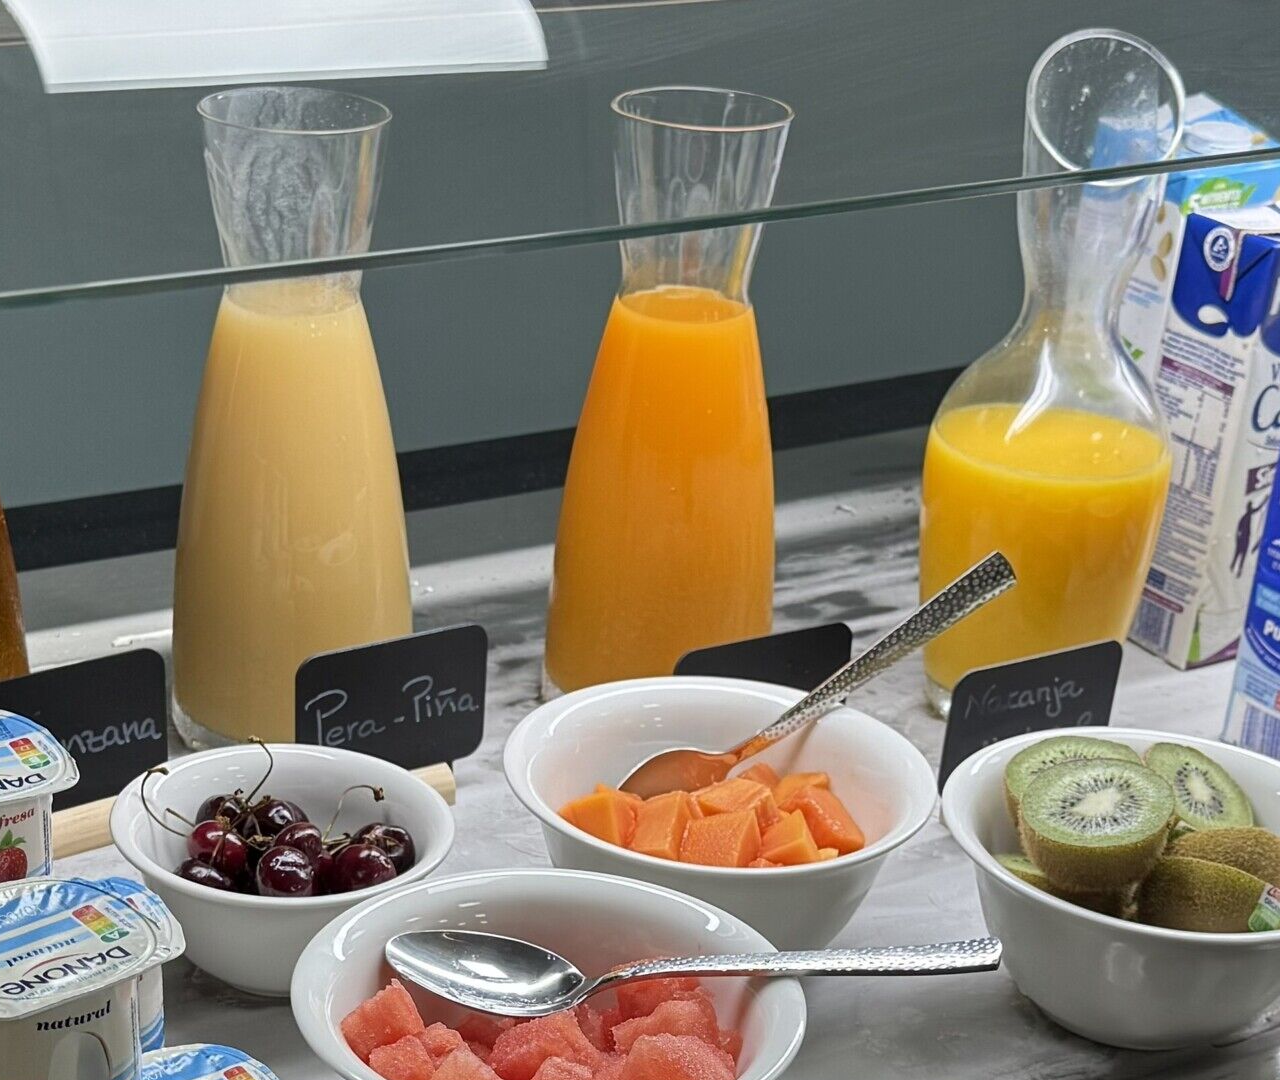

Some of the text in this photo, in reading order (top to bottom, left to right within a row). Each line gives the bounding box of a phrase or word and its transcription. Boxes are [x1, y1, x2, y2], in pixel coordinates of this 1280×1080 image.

[304, 688, 386, 750] Pera
[402, 673, 480, 726] Piña
[62, 715, 163, 756] nzana
[0, 945, 132, 995] DANONE
[6, 937, 76, 968] natural
[36, 1000, 112, 1032] natural
